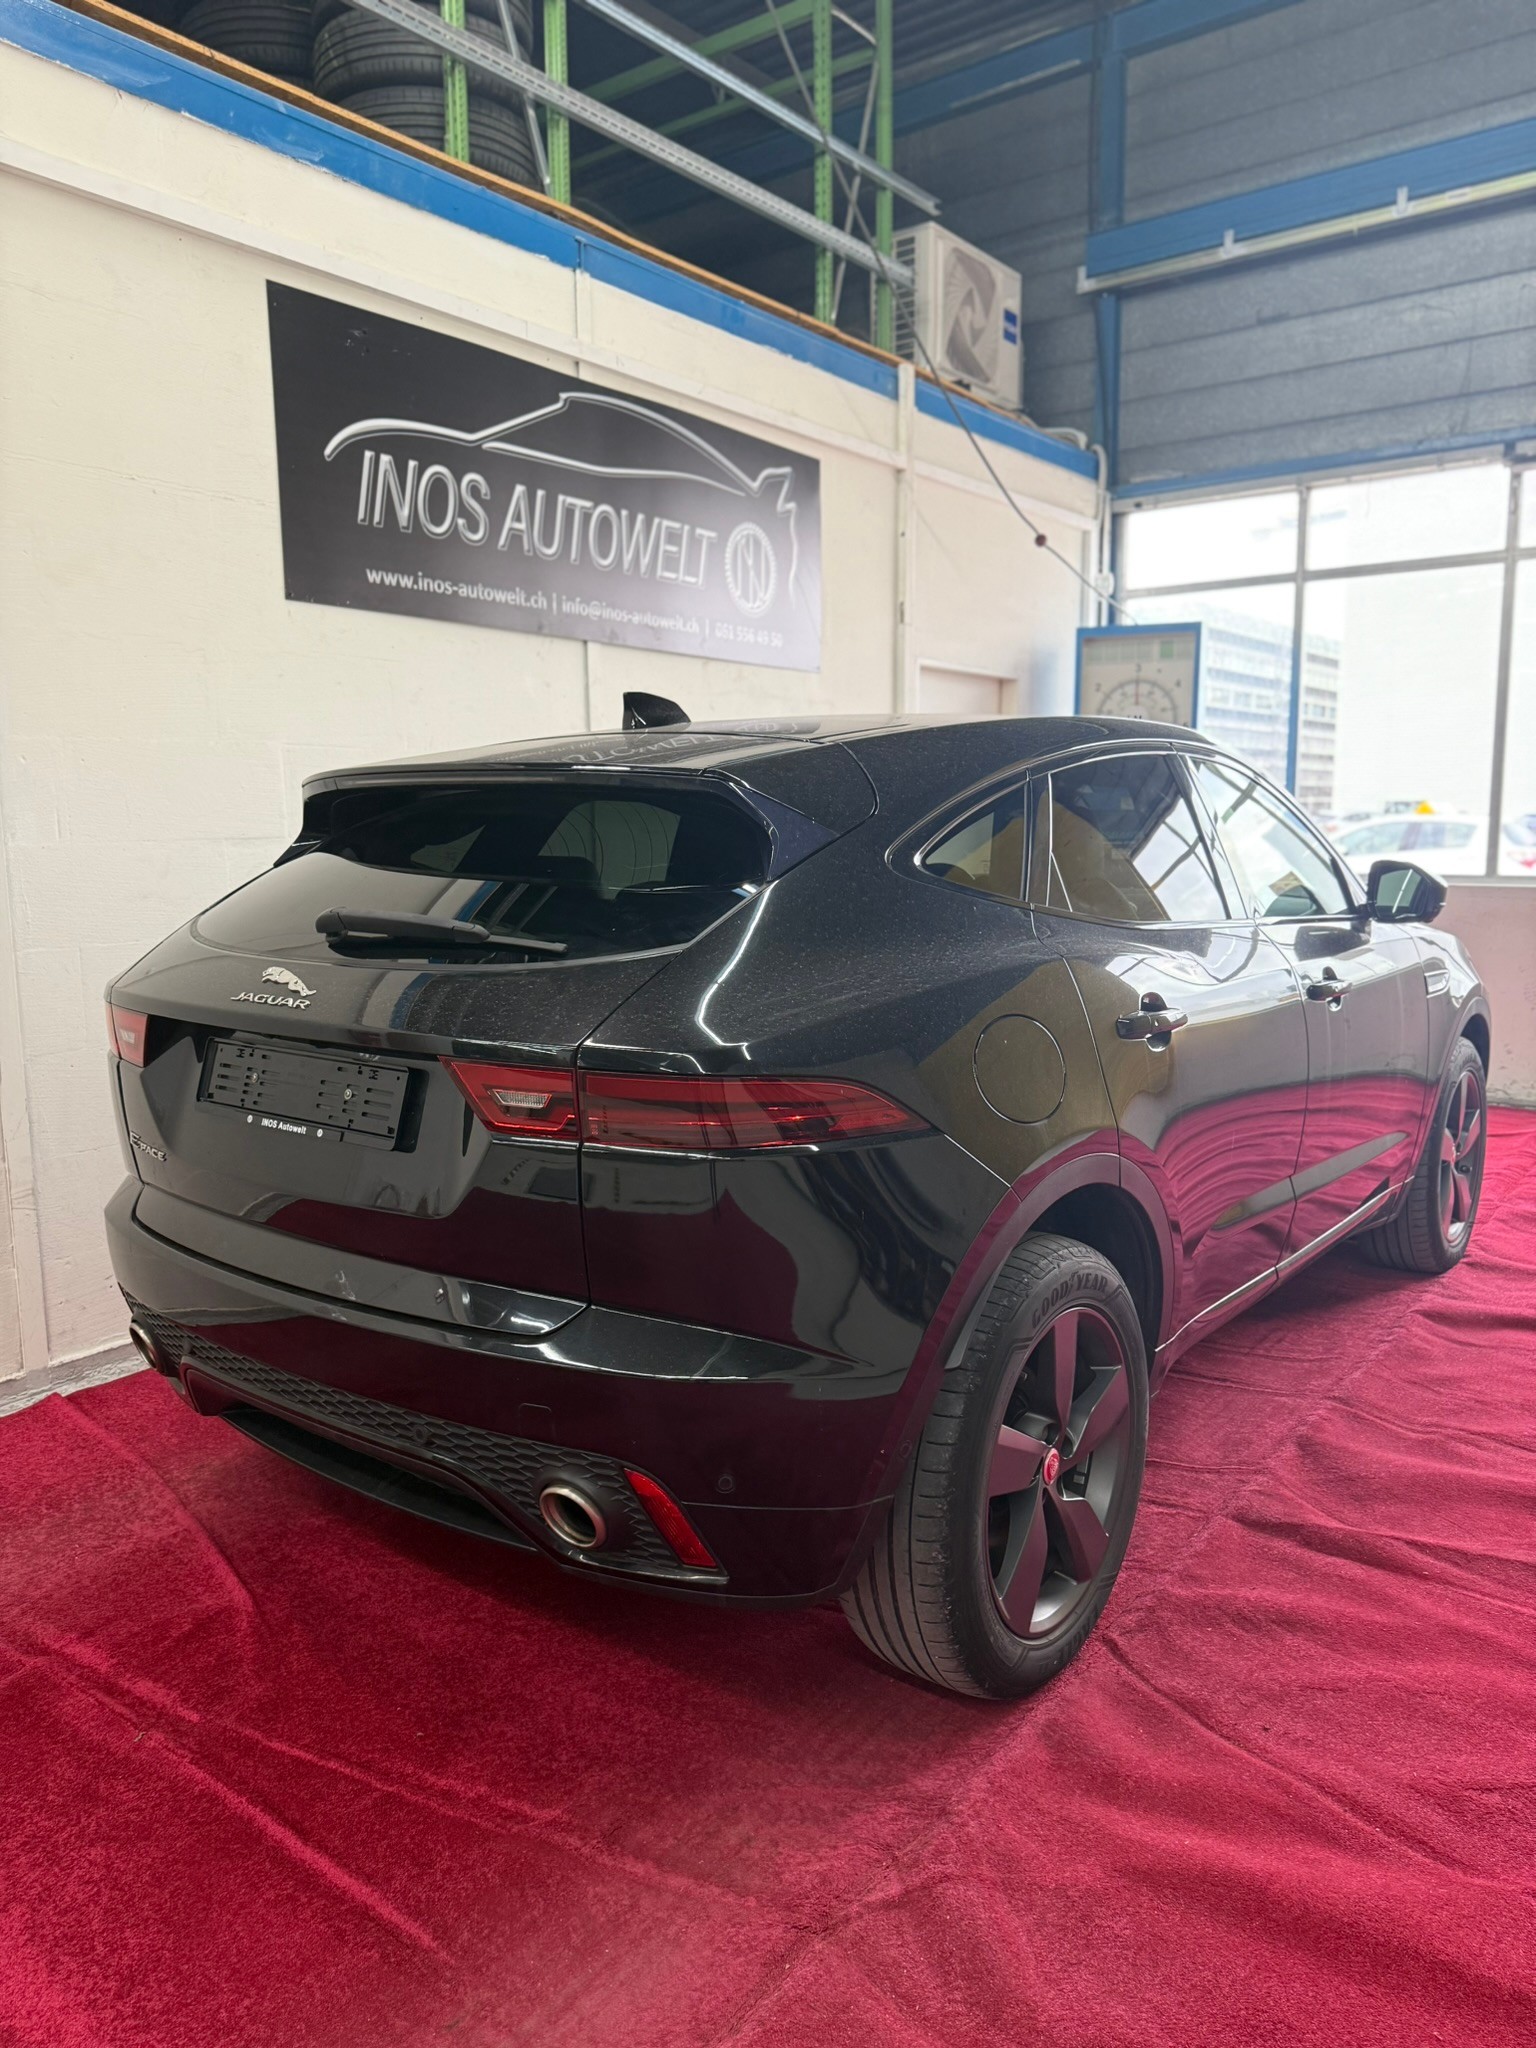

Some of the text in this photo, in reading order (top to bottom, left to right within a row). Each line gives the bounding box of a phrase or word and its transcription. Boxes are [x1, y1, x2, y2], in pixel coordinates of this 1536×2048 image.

[356, 450, 718, 590] INOS AUTOWELT
[365, 567, 548, 611] www.inos-autowelt.ch
[561, 595, 700, 634] info@inos-autowelt.ch
[230, 991, 312, 1011] JAGUAR
[261, 1117, 307, 1135] INOS Autowelt
[1031, 1272, 1109, 1330] GOODYEAR
